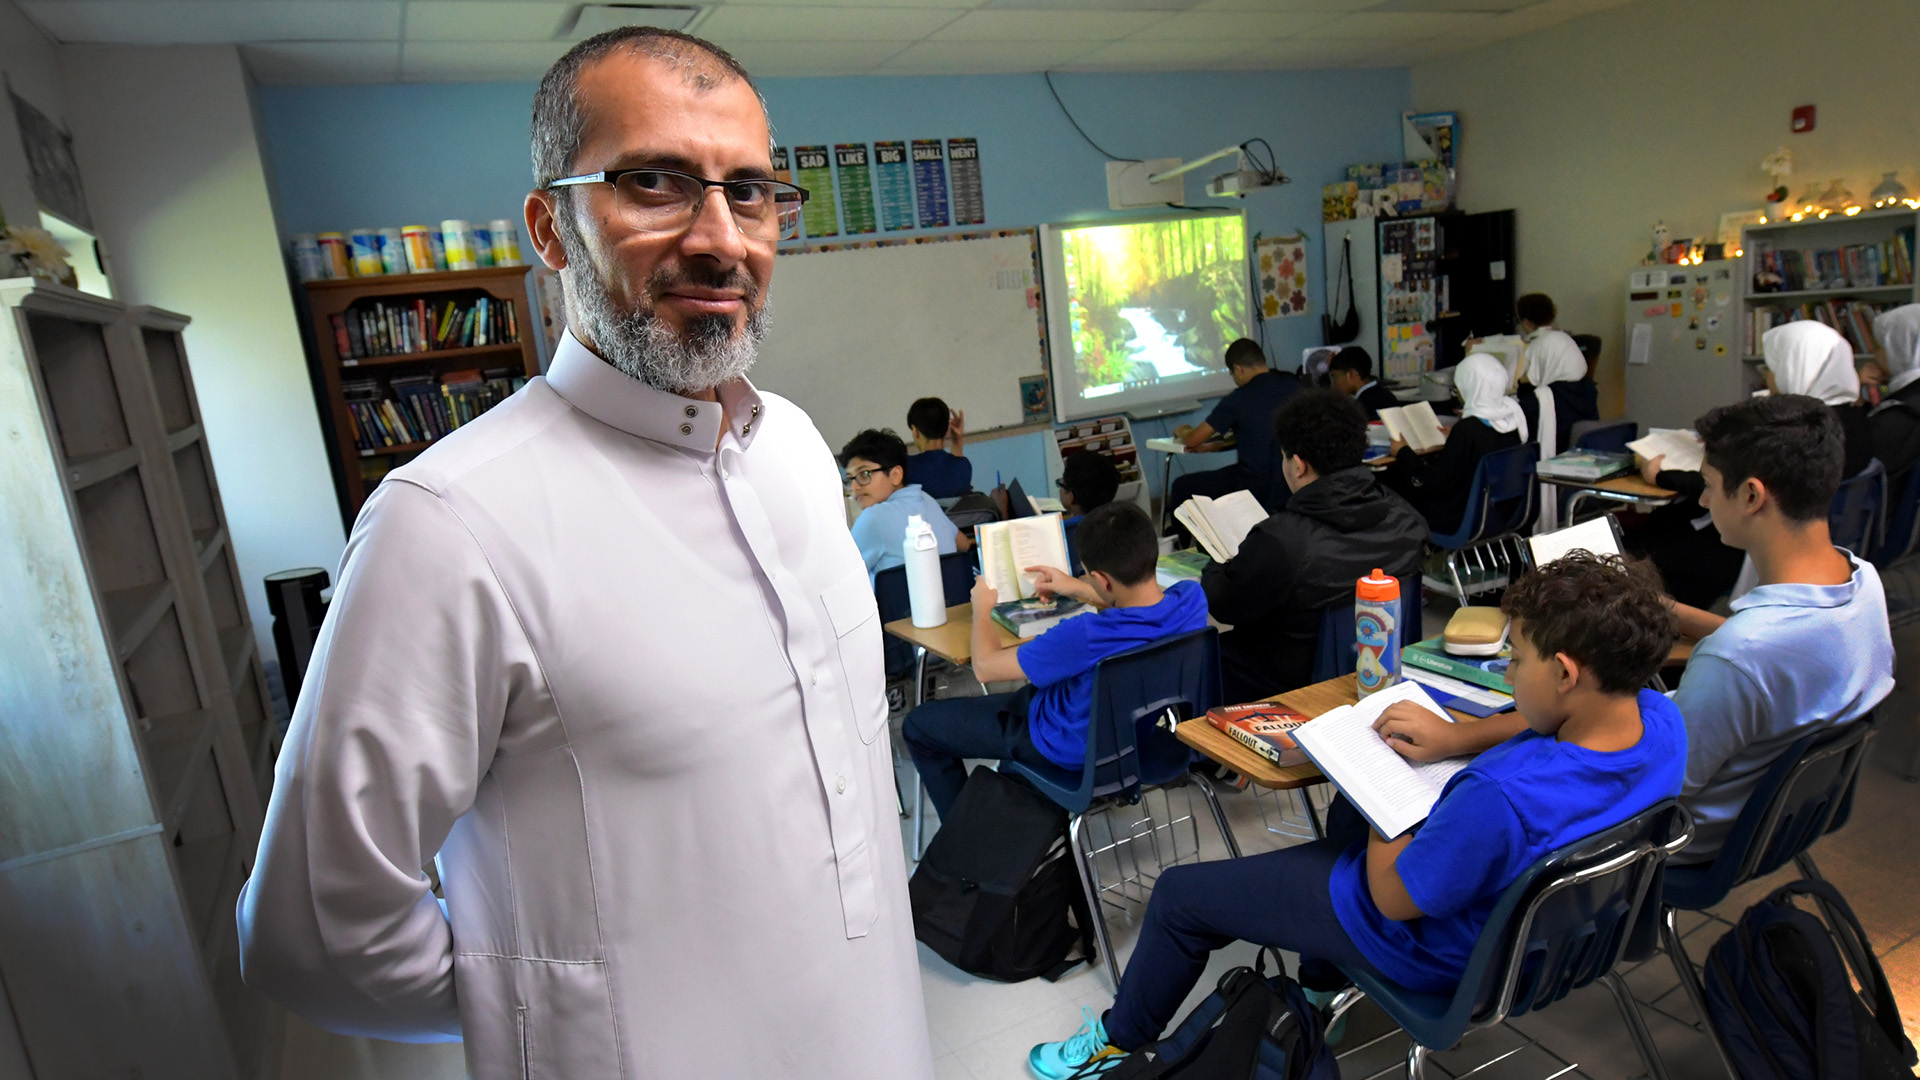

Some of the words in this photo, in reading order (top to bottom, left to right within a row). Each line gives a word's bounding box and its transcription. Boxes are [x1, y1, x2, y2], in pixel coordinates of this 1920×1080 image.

[838, 152, 865, 165] LIKE
[880, 149, 901, 163] BIG
[912, 148, 942, 161] SMALL
[949, 147, 977, 159] WENT
[800, 155, 825, 168] SAD
[1372, 188, 1398, 217] R
[1426, 657, 1453, 671] Literature
[1255, 721, 1307, 732] FALLOUT
[1228, 726, 1258, 749] FALLOUT
